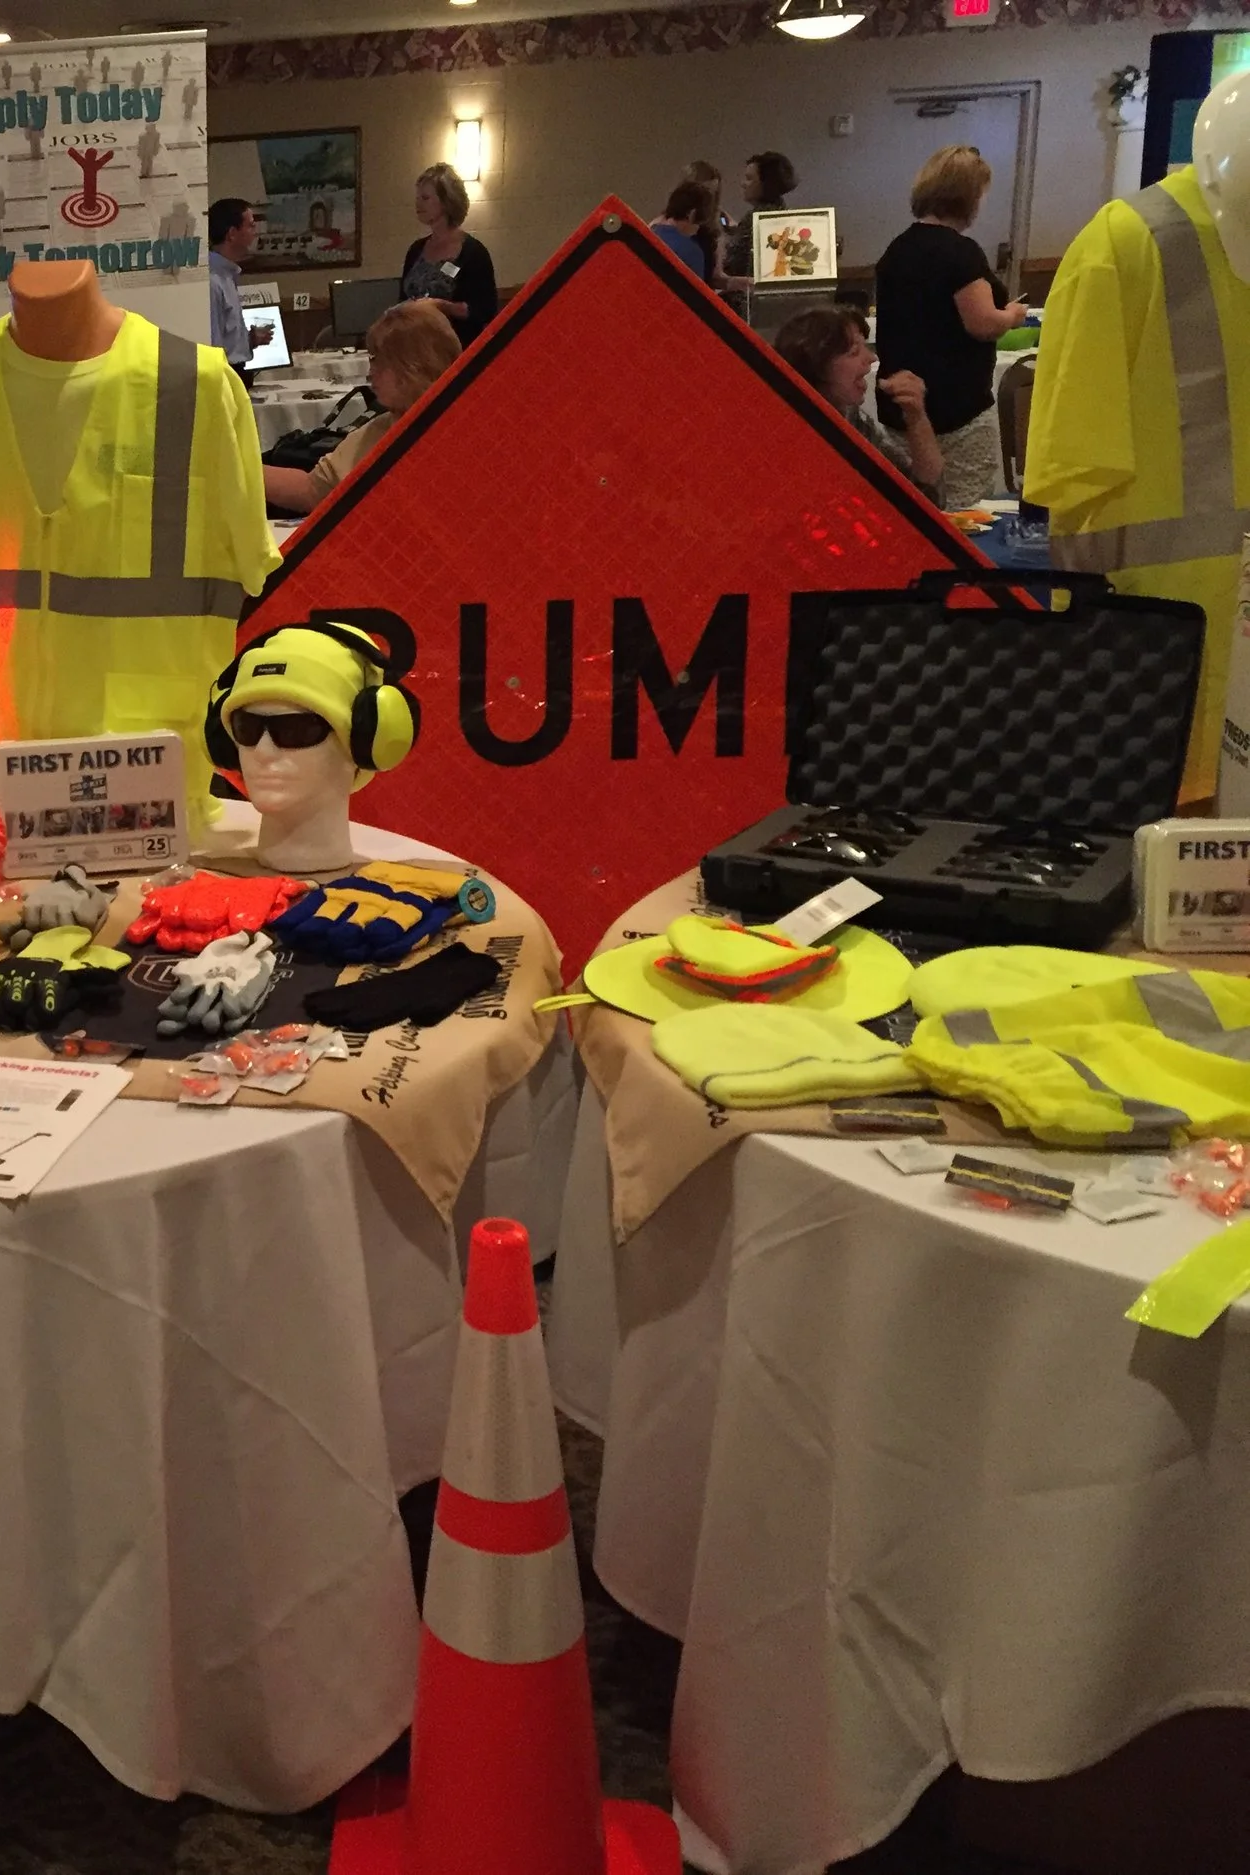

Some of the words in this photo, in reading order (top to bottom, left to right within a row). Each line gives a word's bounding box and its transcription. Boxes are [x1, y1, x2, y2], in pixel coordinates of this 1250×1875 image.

[54, 83, 163, 124] Today
[49, 132, 118, 148] JOBS
[295, 295, 308, 307] 42
[6, 752, 74, 776] FIRST
[78, 749, 123, 771] AID
[127, 746, 166, 767] KIT
[147, 838, 166, 852] 25
[1178, 840, 1250, 861] FIRST
[31, 1065, 100, 1079] products?
